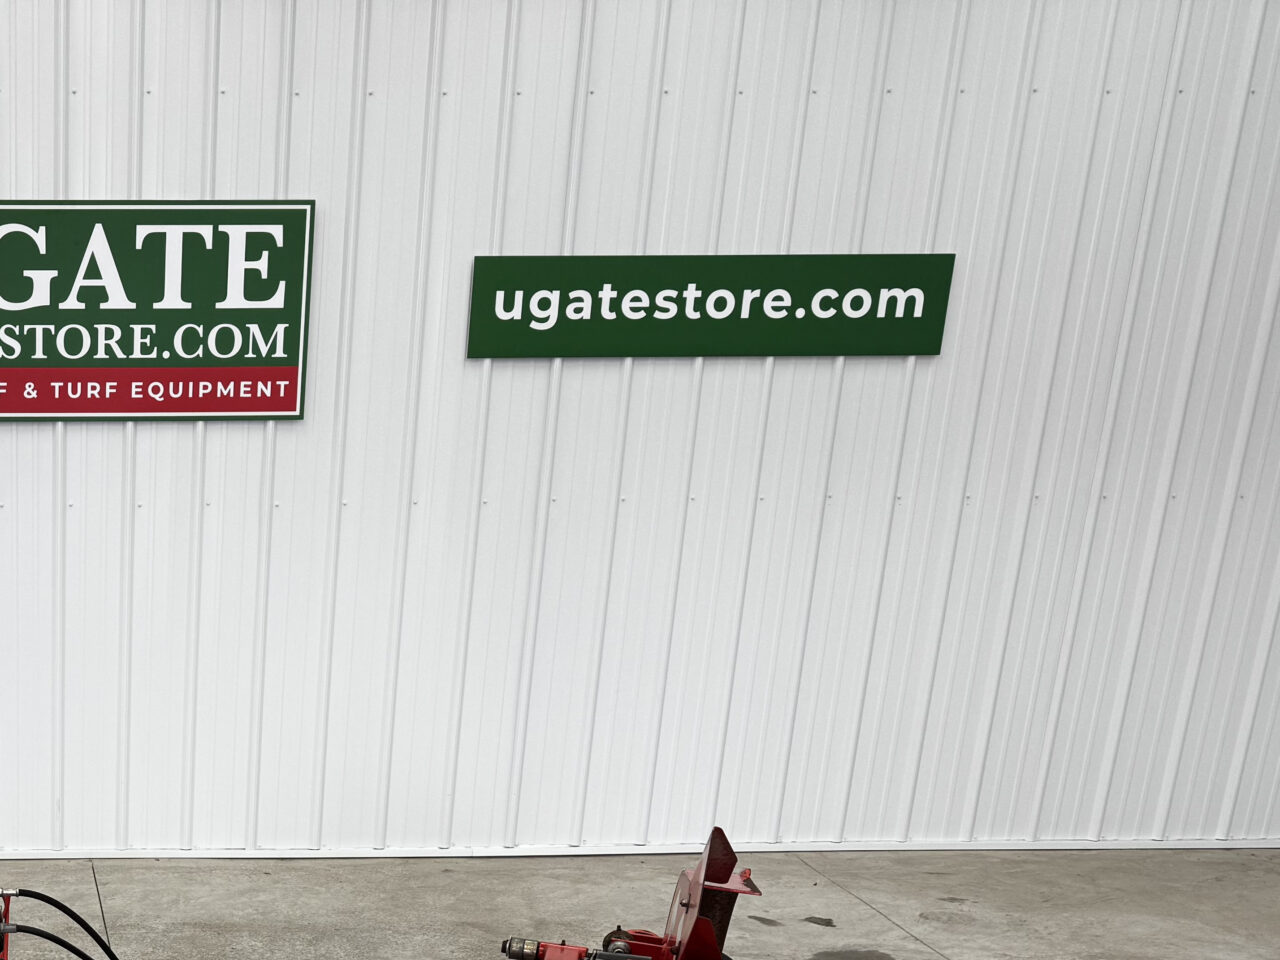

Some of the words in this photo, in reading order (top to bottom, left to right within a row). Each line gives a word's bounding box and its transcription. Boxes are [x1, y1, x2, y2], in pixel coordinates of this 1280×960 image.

[494, 283, 925, 331] ugatestore.com
[23, 382, 39, 399] &
[50, 381, 119, 399] TURF
[131, 380, 290, 402] EQUIPMENT
